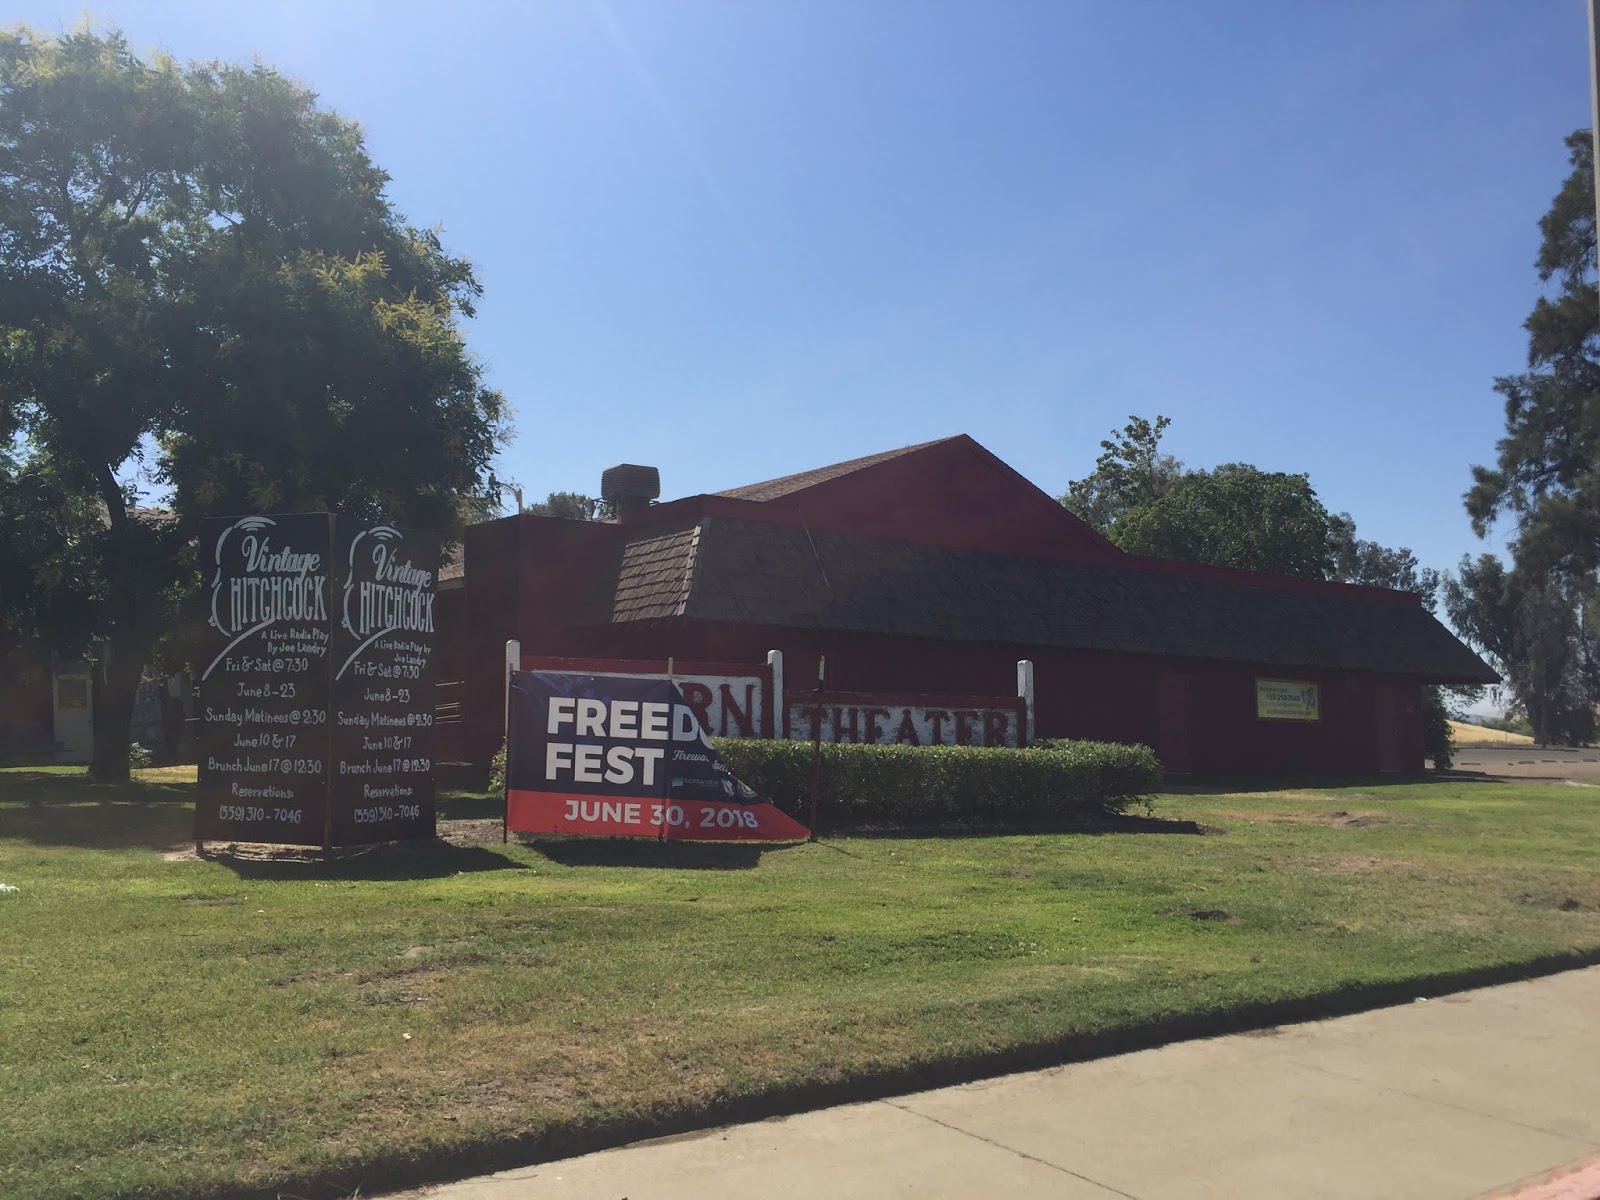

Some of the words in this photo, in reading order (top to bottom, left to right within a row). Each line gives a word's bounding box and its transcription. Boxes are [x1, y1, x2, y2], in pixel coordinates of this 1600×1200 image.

[241, 535, 320, 579] Vintage
[372, 543, 432, 591] Vintage
[230, 576, 328, 631] HITCHCOCK
[360, 581, 435, 635] HITCHCOCK
[261, 630, 267, 640] A
[270, 629, 287, 640] Live
[290, 628, 311, 640] Radio
[312, 628, 329, 644] Play
[267, 642, 278, 655] By
[279, 642, 295, 653] Joe
[297, 641, 327, 657] Landry
[374, 640, 380, 650] A
[380, 640, 393, 650] Live
[394, 640, 410, 651] Radio
[410, 641, 423, 655] Play
[424, 644, 432, 655] by
[225, 657, 240, 671] Fri
[241, 656, 254, 672] &
[286, 658, 308, 672] 7:30
[394, 652, 406, 663] Joe
[406, 654, 427, 669] Landry
[353, 661, 366, 675] Fri
[367, 662, 377, 676] &
[402, 665, 420, 679] 7:30
[237, 682, 262, 698] June
[205, 707, 243, 726] Sunday
[678, 682, 757, 738] RN
[337, 711, 370, 729] Sunday
[801, 706, 1009, 746] THEATER
[233, 733, 258, 748] June
[285, 735, 297, 748] 17
[362, 736, 383, 750] June
[403, 736, 412, 749] 17
[208, 756, 242, 772] Brunch
[340, 760, 372, 775] Brunch
[545, 742, 665, 786] FEST
[564, 799, 641, 824] JUNE
[650, 804, 690, 829] 30,
[700, 807, 759, 829] 2018
